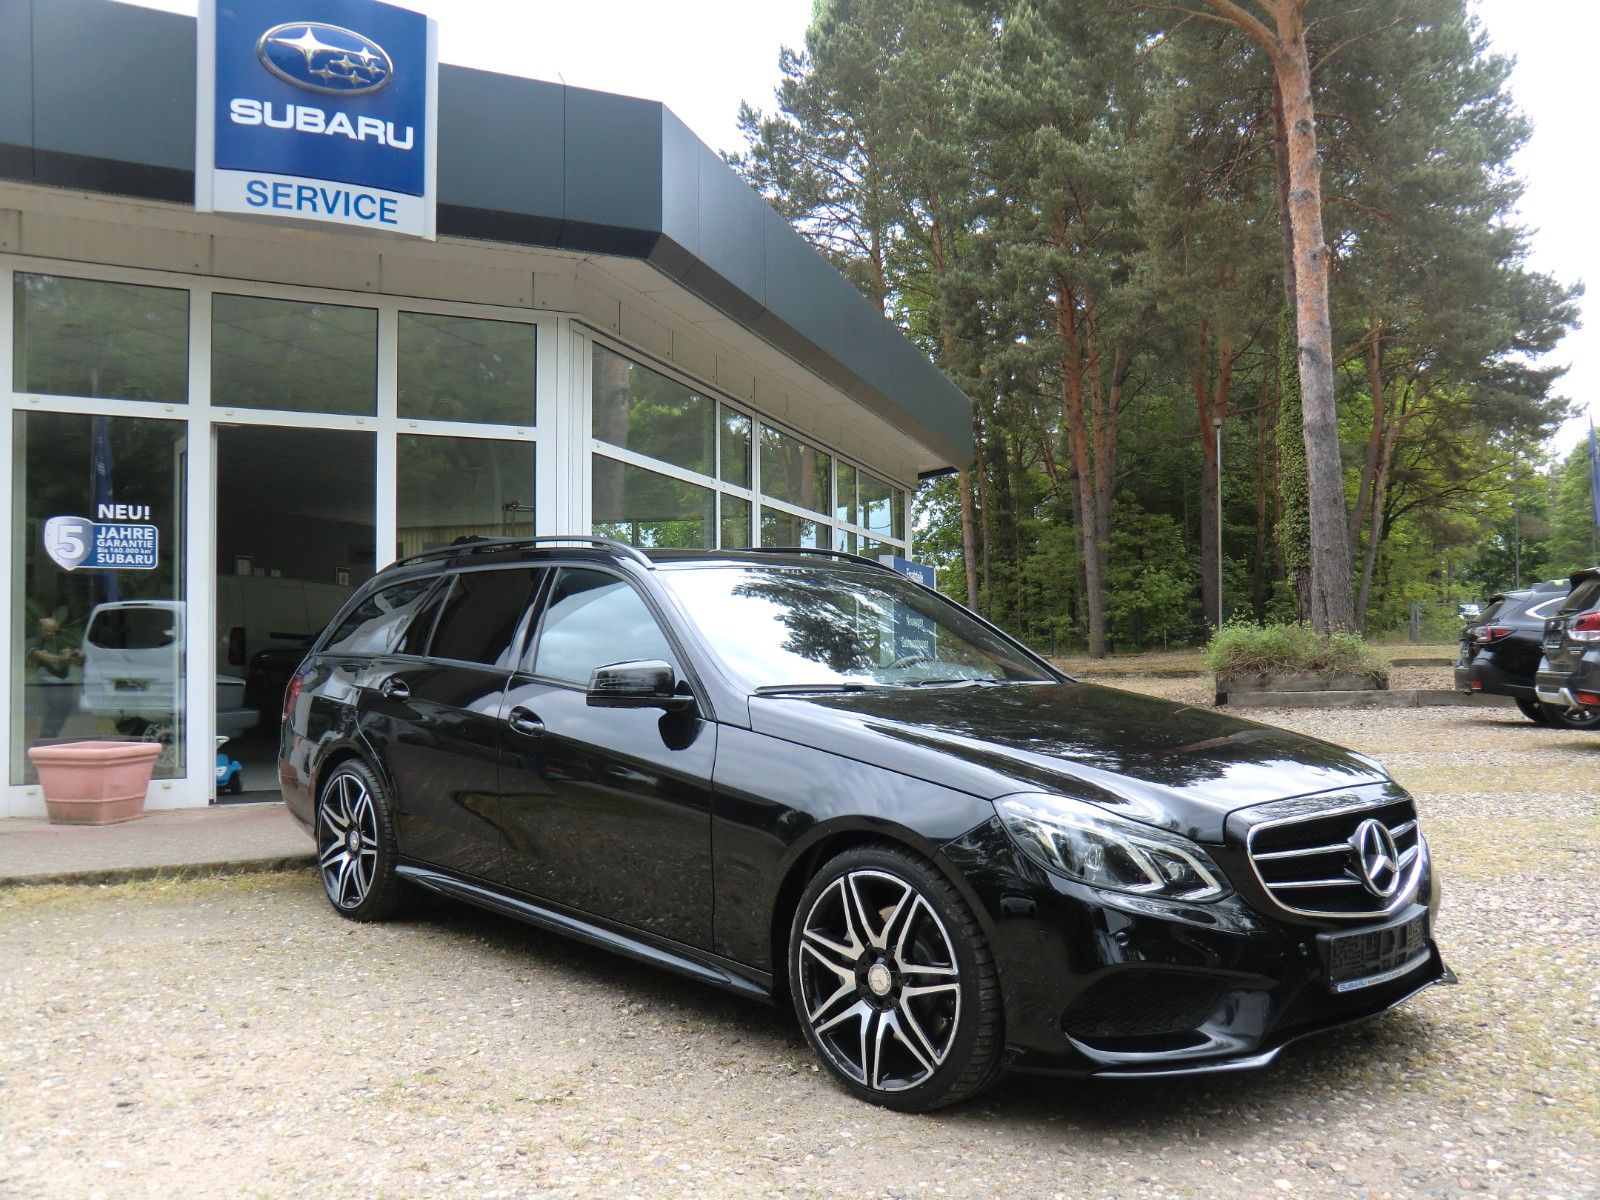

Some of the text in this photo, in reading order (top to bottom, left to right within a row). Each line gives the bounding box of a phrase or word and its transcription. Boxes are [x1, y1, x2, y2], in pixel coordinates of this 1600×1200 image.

[230, 98, 414, 150] SUBARU
[246, 180, 398, 225] SERVICE
[98, 504, 150, 520] NEU!
[97, 527, 154, 539] JAHRE
[55, 525, 84, 559] 5
[97, 539, 154, 548] GARANTIE
[97, 553, 153, 564] SUBARU
